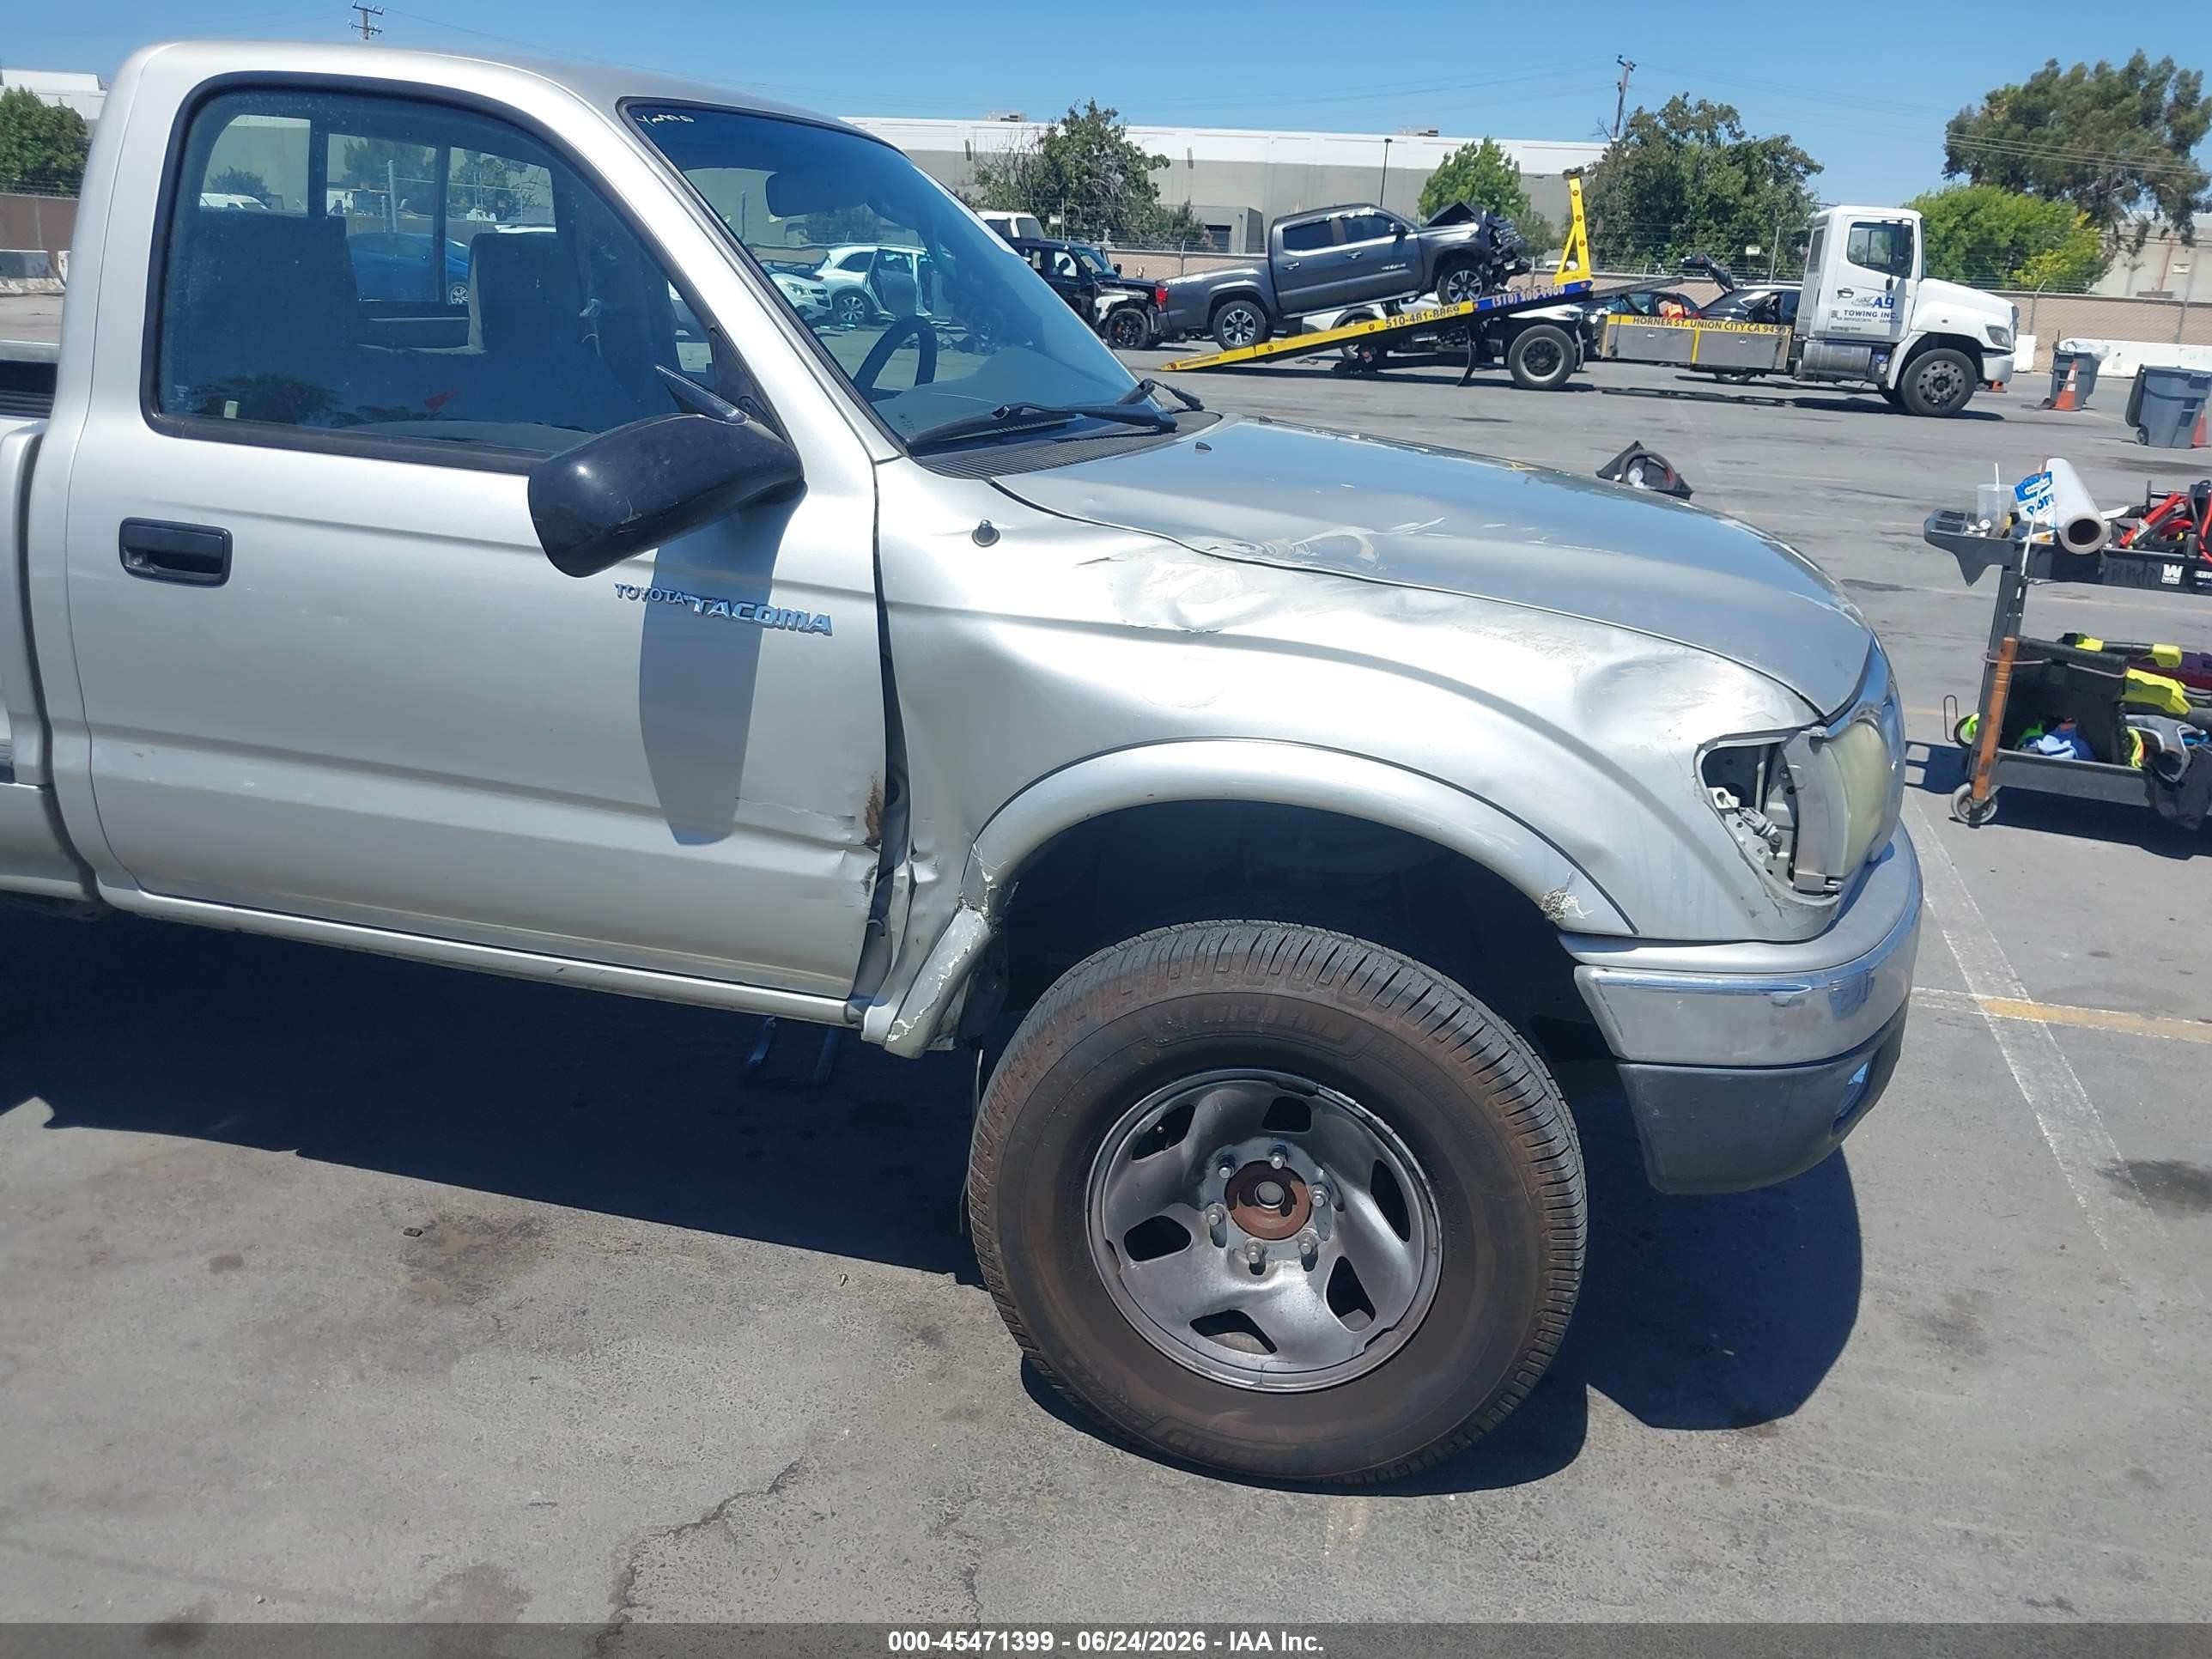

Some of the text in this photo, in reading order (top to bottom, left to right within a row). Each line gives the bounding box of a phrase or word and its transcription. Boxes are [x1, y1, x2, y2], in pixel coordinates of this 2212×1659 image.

[1871, 296, 1895, 309] A9
[1386, 307, 1460, 328] 510-481-8869
[1633, 316, 1672, 326] HORNER
[1690, 320, 1722, 330] UNION
[1724, 321, 1746, 331] CITY
[1747, 323, 1760, 332] CA
[614, 583, 833, 636] TOYOTA TACOMA
